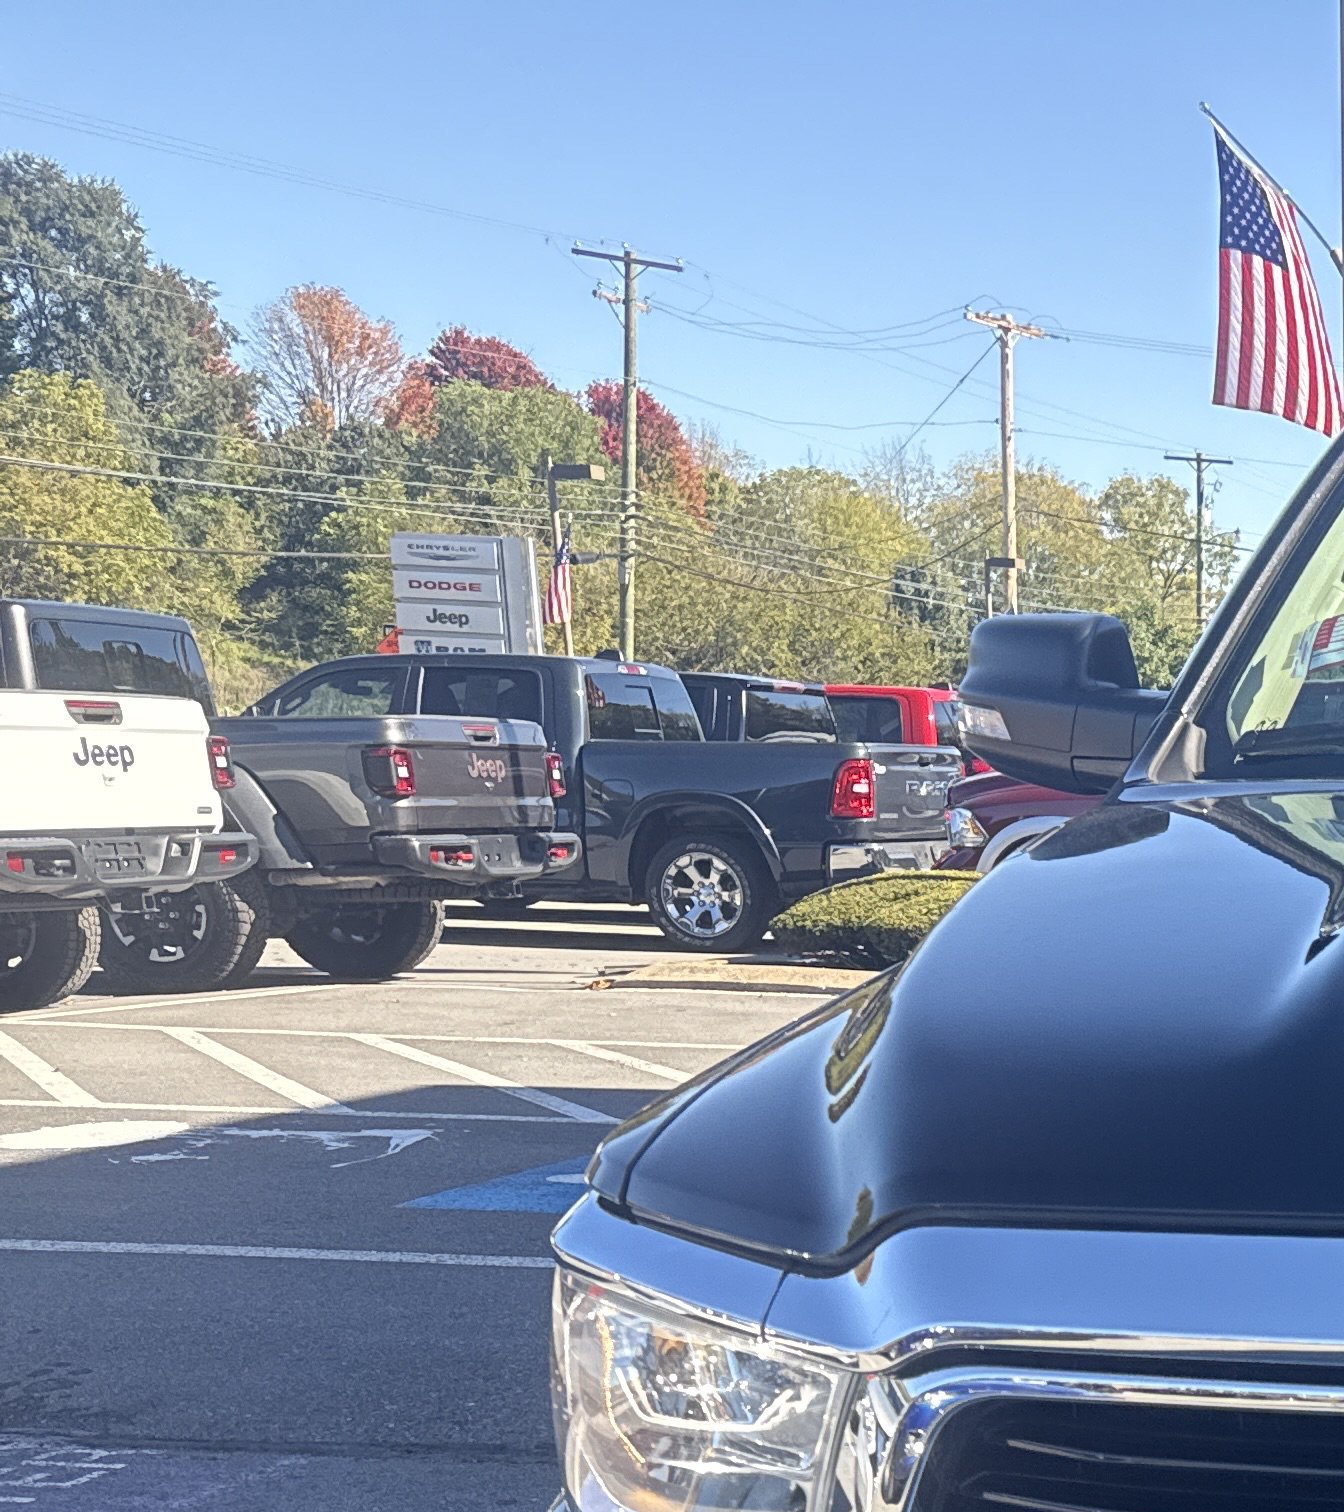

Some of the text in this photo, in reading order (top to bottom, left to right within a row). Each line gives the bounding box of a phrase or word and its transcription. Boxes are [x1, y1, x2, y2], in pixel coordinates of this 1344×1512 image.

[407, 543, 477, 552] CHRYSLER
[408, 580, 482, 592] DODGE
[426, 608, 470, 628] Jeep
[73, 736, 134, 772] Jeep
[468, 752, 506, 782] Jeep
